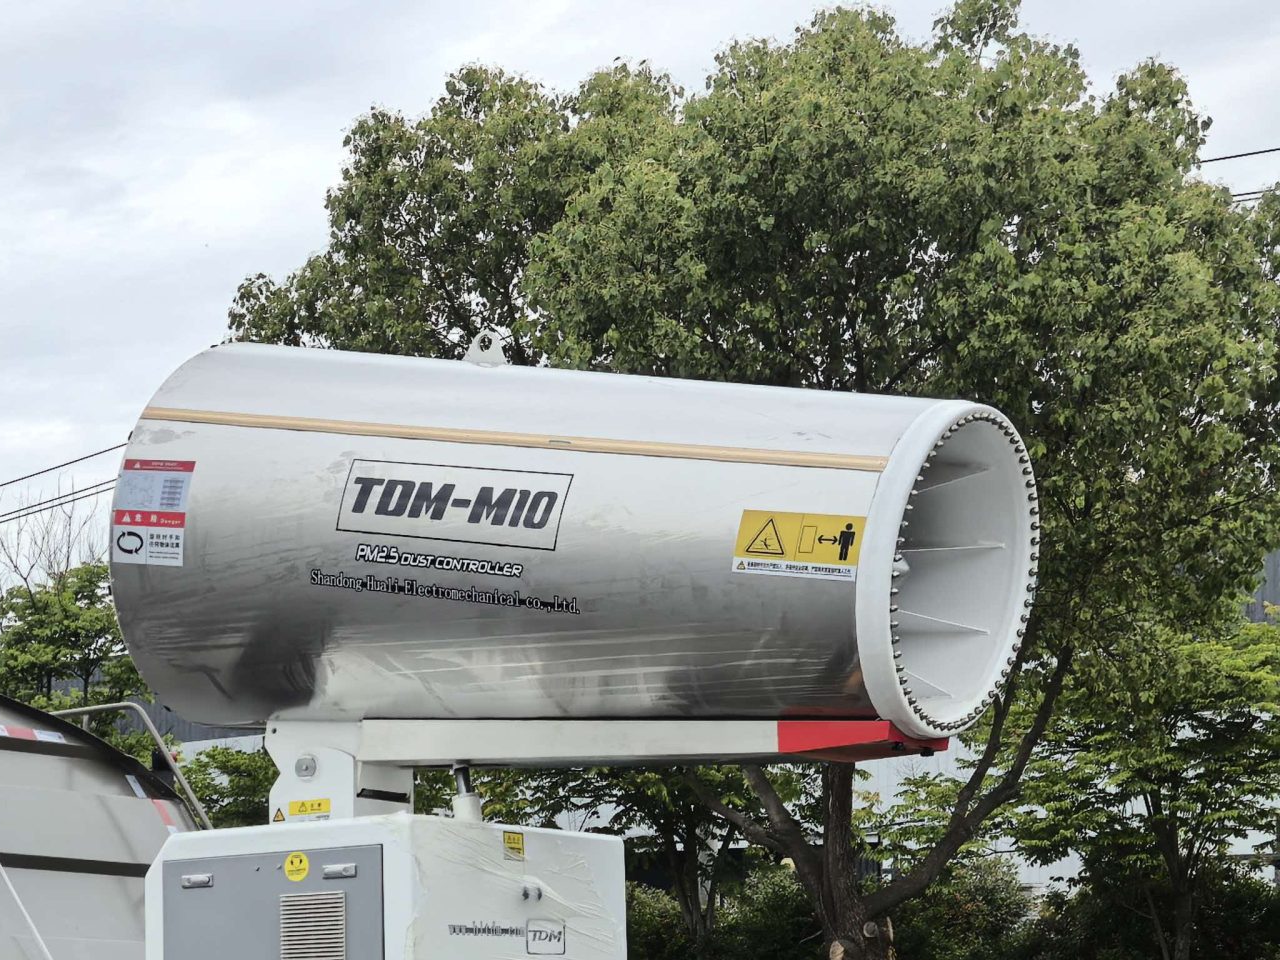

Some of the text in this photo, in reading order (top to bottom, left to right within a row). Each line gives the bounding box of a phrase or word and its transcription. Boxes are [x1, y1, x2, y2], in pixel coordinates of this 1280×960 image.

[351, 476, 559, 530] TDM-M10
[355, 544, 523, 578] PM2.5 DUST CONTROLLER
[311, 569, 369, 592] Shandong
[367, 576, 399, 594] Huali
[403, 580, 521, 607] Electromechanical
[528, 929, 563, 943] TDM
